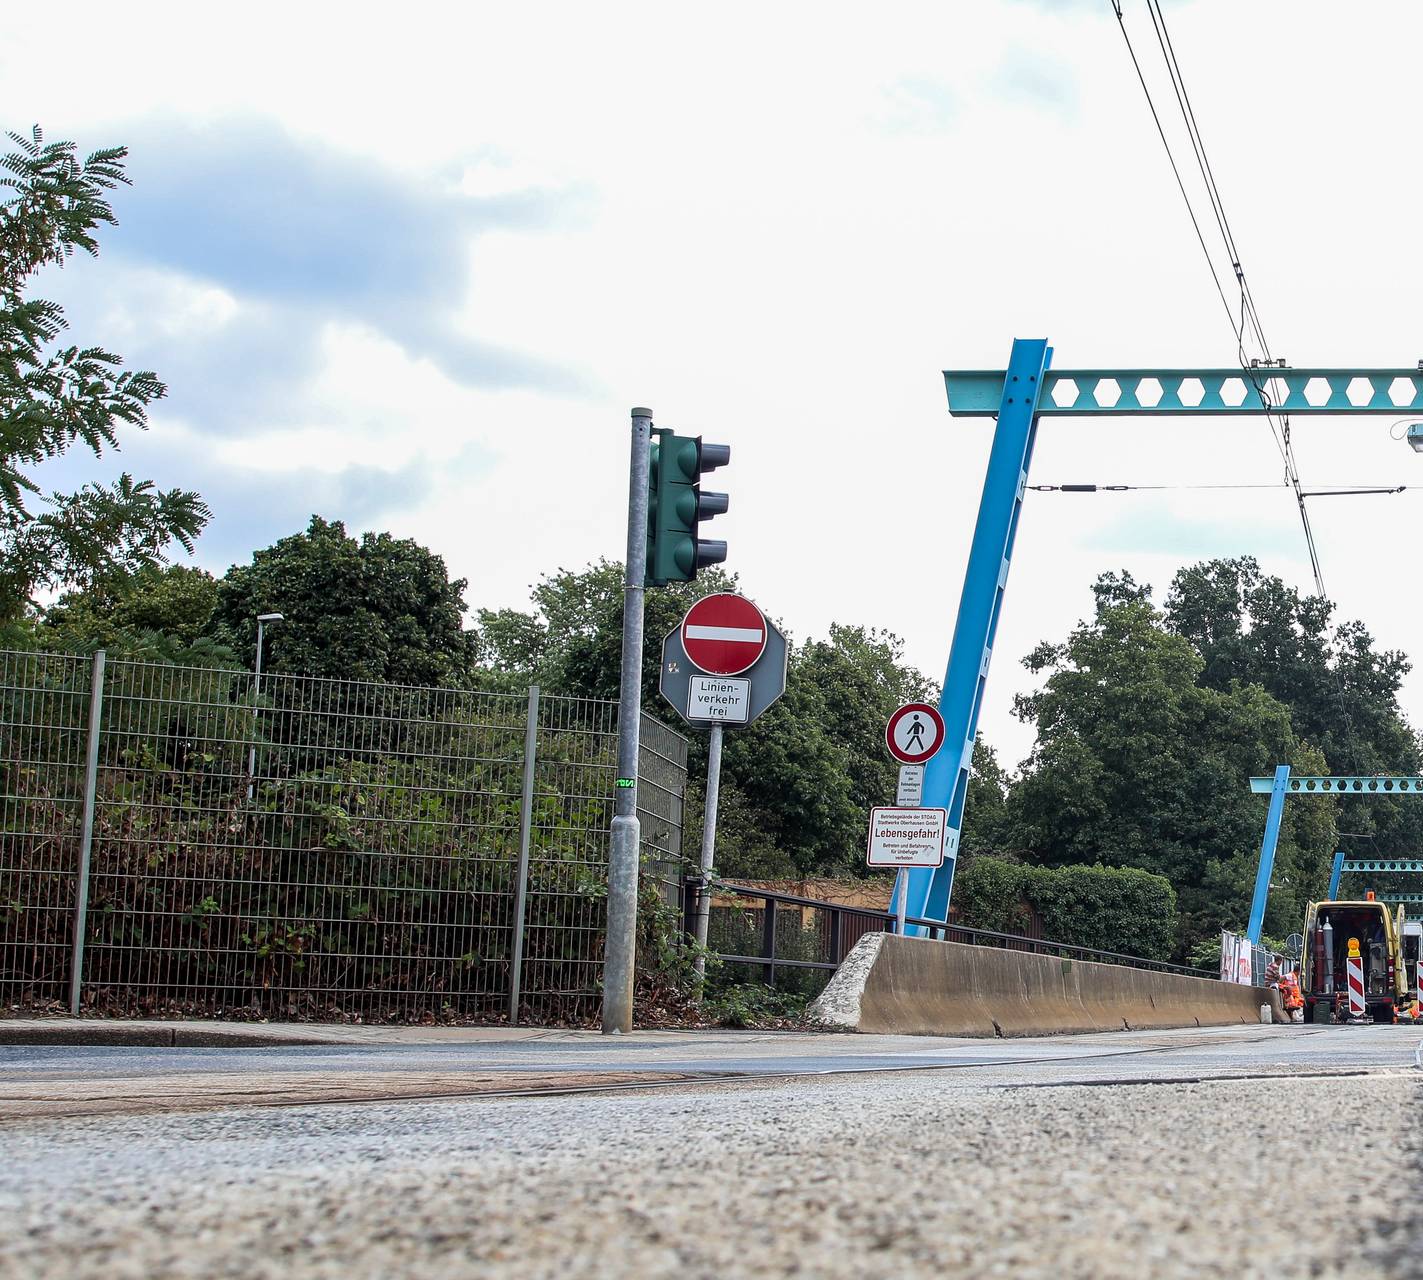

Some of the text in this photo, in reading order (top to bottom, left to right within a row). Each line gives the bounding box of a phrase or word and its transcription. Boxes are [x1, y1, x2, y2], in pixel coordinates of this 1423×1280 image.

[701, 681, 739, 692] Linien-
[698, 694, 740, 704] verkehr
[709, 706, 728, 716] frei
[875, 828, 940, 840] Lebensgefahr!
